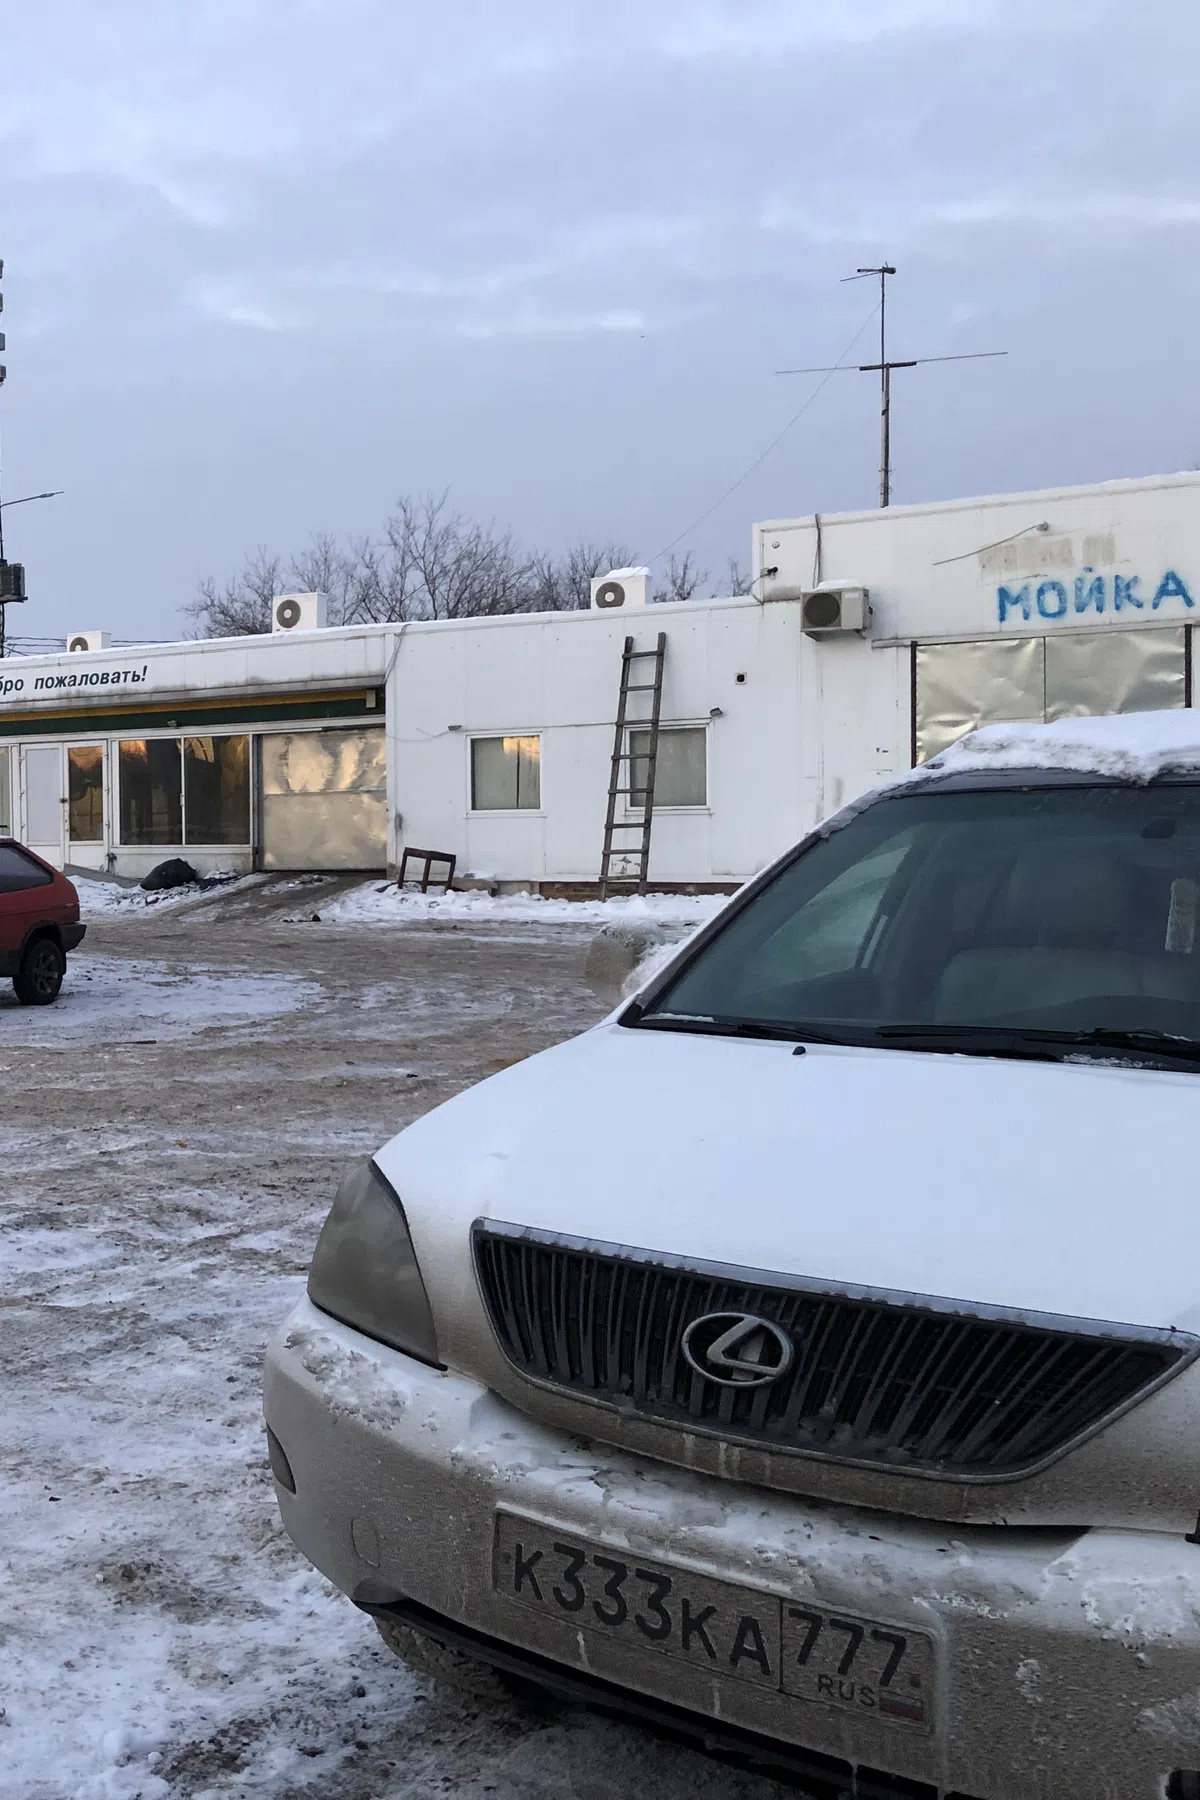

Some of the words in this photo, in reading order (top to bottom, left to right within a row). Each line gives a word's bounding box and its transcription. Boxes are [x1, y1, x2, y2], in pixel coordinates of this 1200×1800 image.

[996, 566, 1195, 623] МОЙКА
[34, 665, 148, 690] пожаловать!
[513, 1541, 772, 1677] К333КА
[788, 1607, 907, 1688] 777
[817, 1673, 876, 1709] RUS
